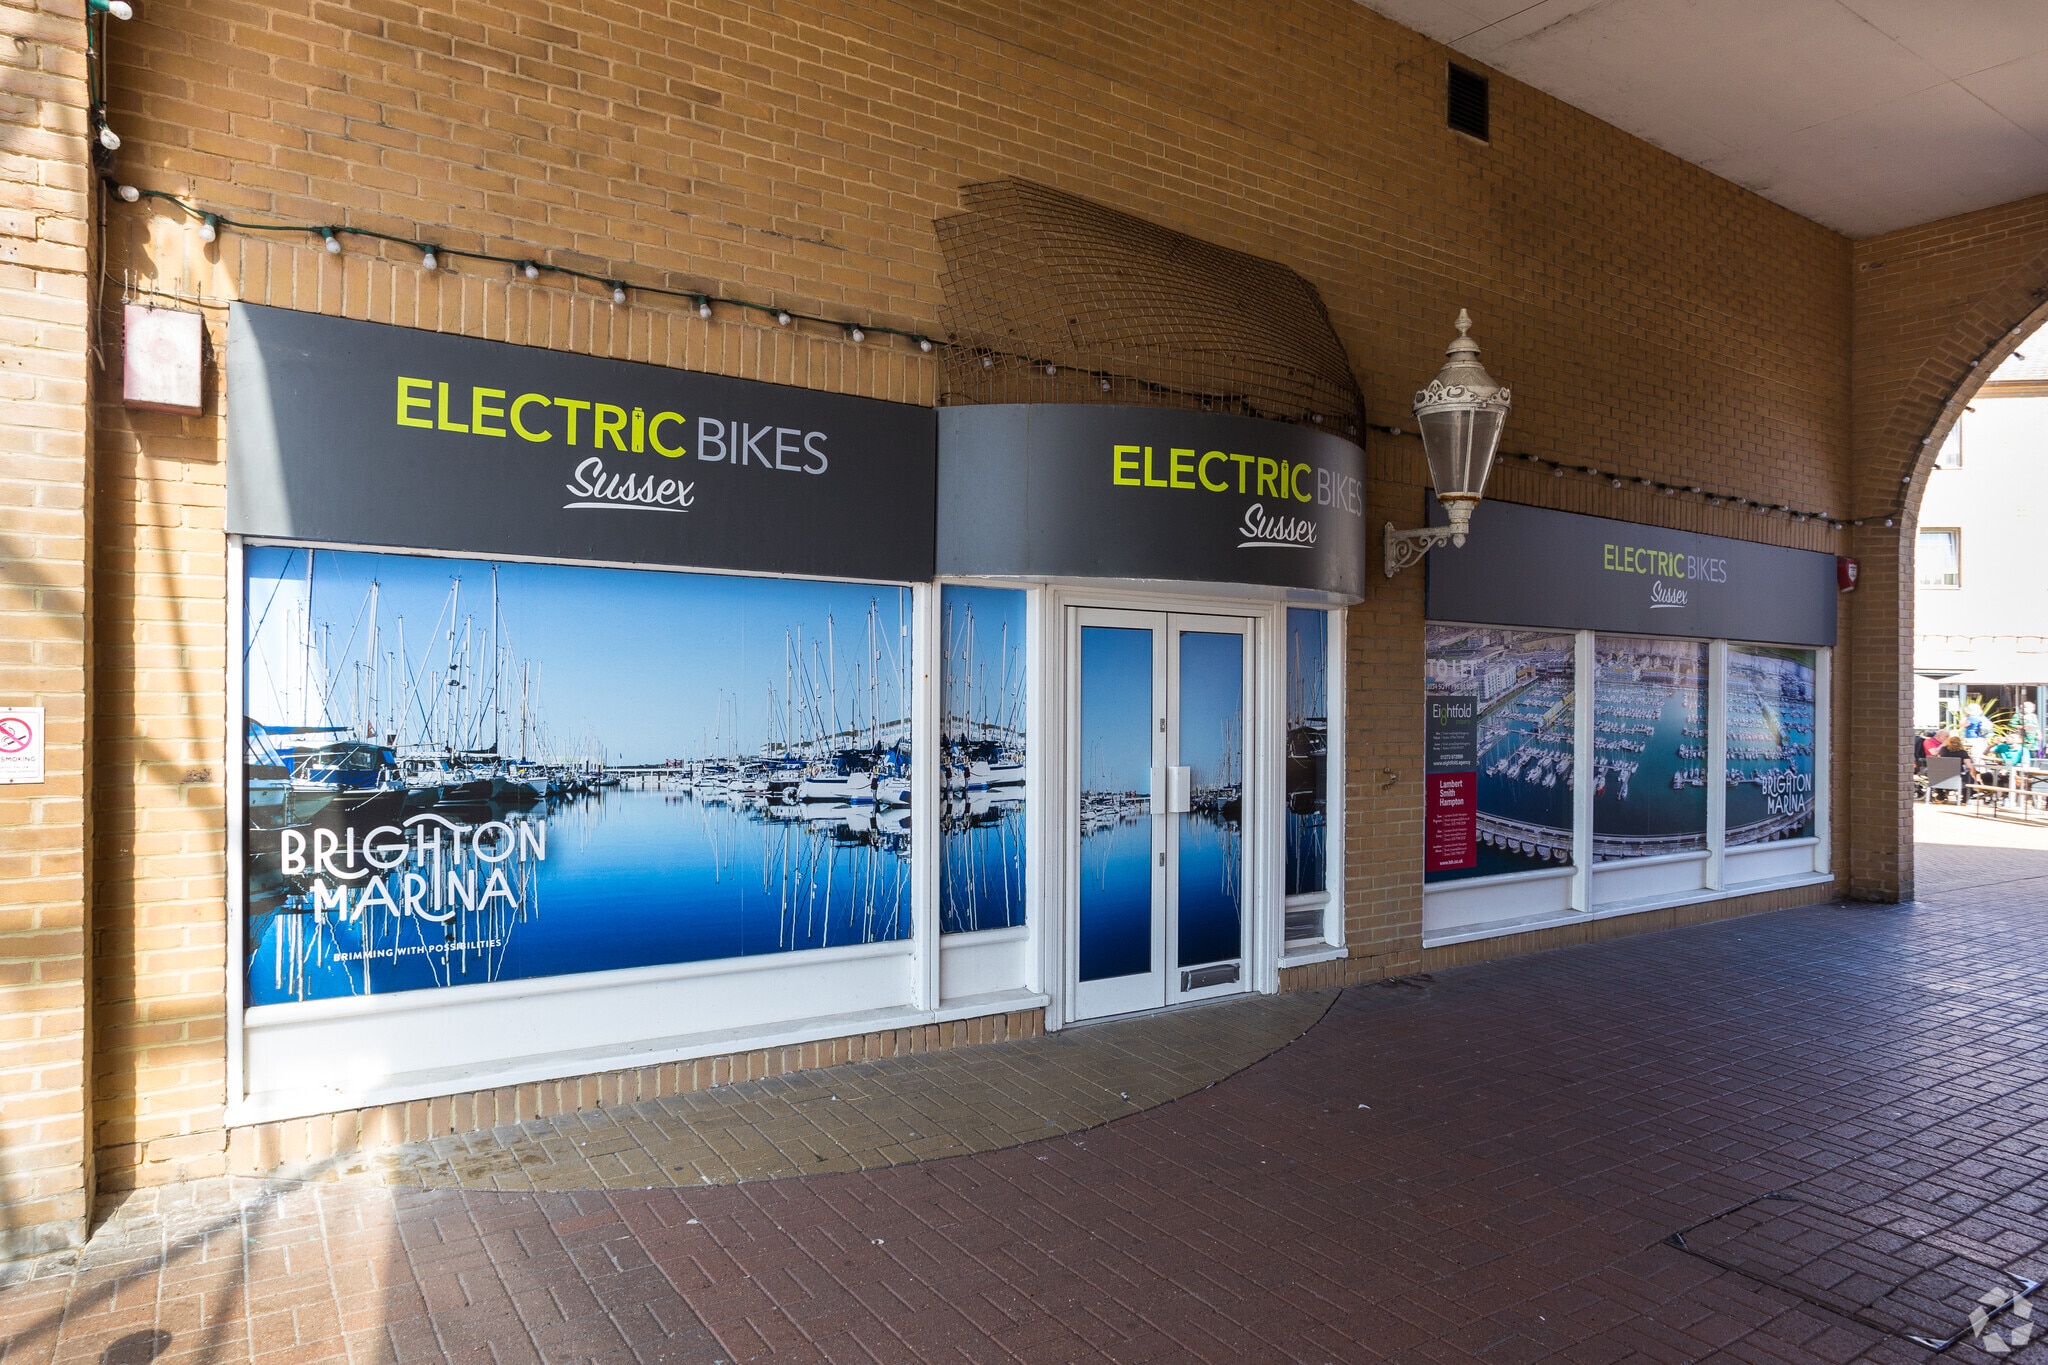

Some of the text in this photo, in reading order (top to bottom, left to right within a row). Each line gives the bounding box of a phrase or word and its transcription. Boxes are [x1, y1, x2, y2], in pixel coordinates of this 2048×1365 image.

[397, 376, 829, 475] ELECTRIC BIKES
[565, 456, 695, 508] Sussex
[1113, 444, 1363, 518] ELECTRIC BIKES
[1238, 502, 1317, 544] Sussex
[1604, 543, 1727, 584] ELECTRIC BIKES
[1650, 580, 1688, 605] Sussex
[1427, 658, 1478, 678] TO LET
[1439, 780, 1463, 789] Lambert
[1439, 789, 1456, 798] Smith
[1761, 770, 1812, 797] BRIGHTON
[1439, 798, 1464, 807] Hampton
[1767, 794, 1806, 816] MARINA
[280, 813, 546, 879] BRIGHTON
[313, 868, 518, 923] MARINA
[333, 939, 502, 962] BRIMMING WITH POSSIBILITIES
